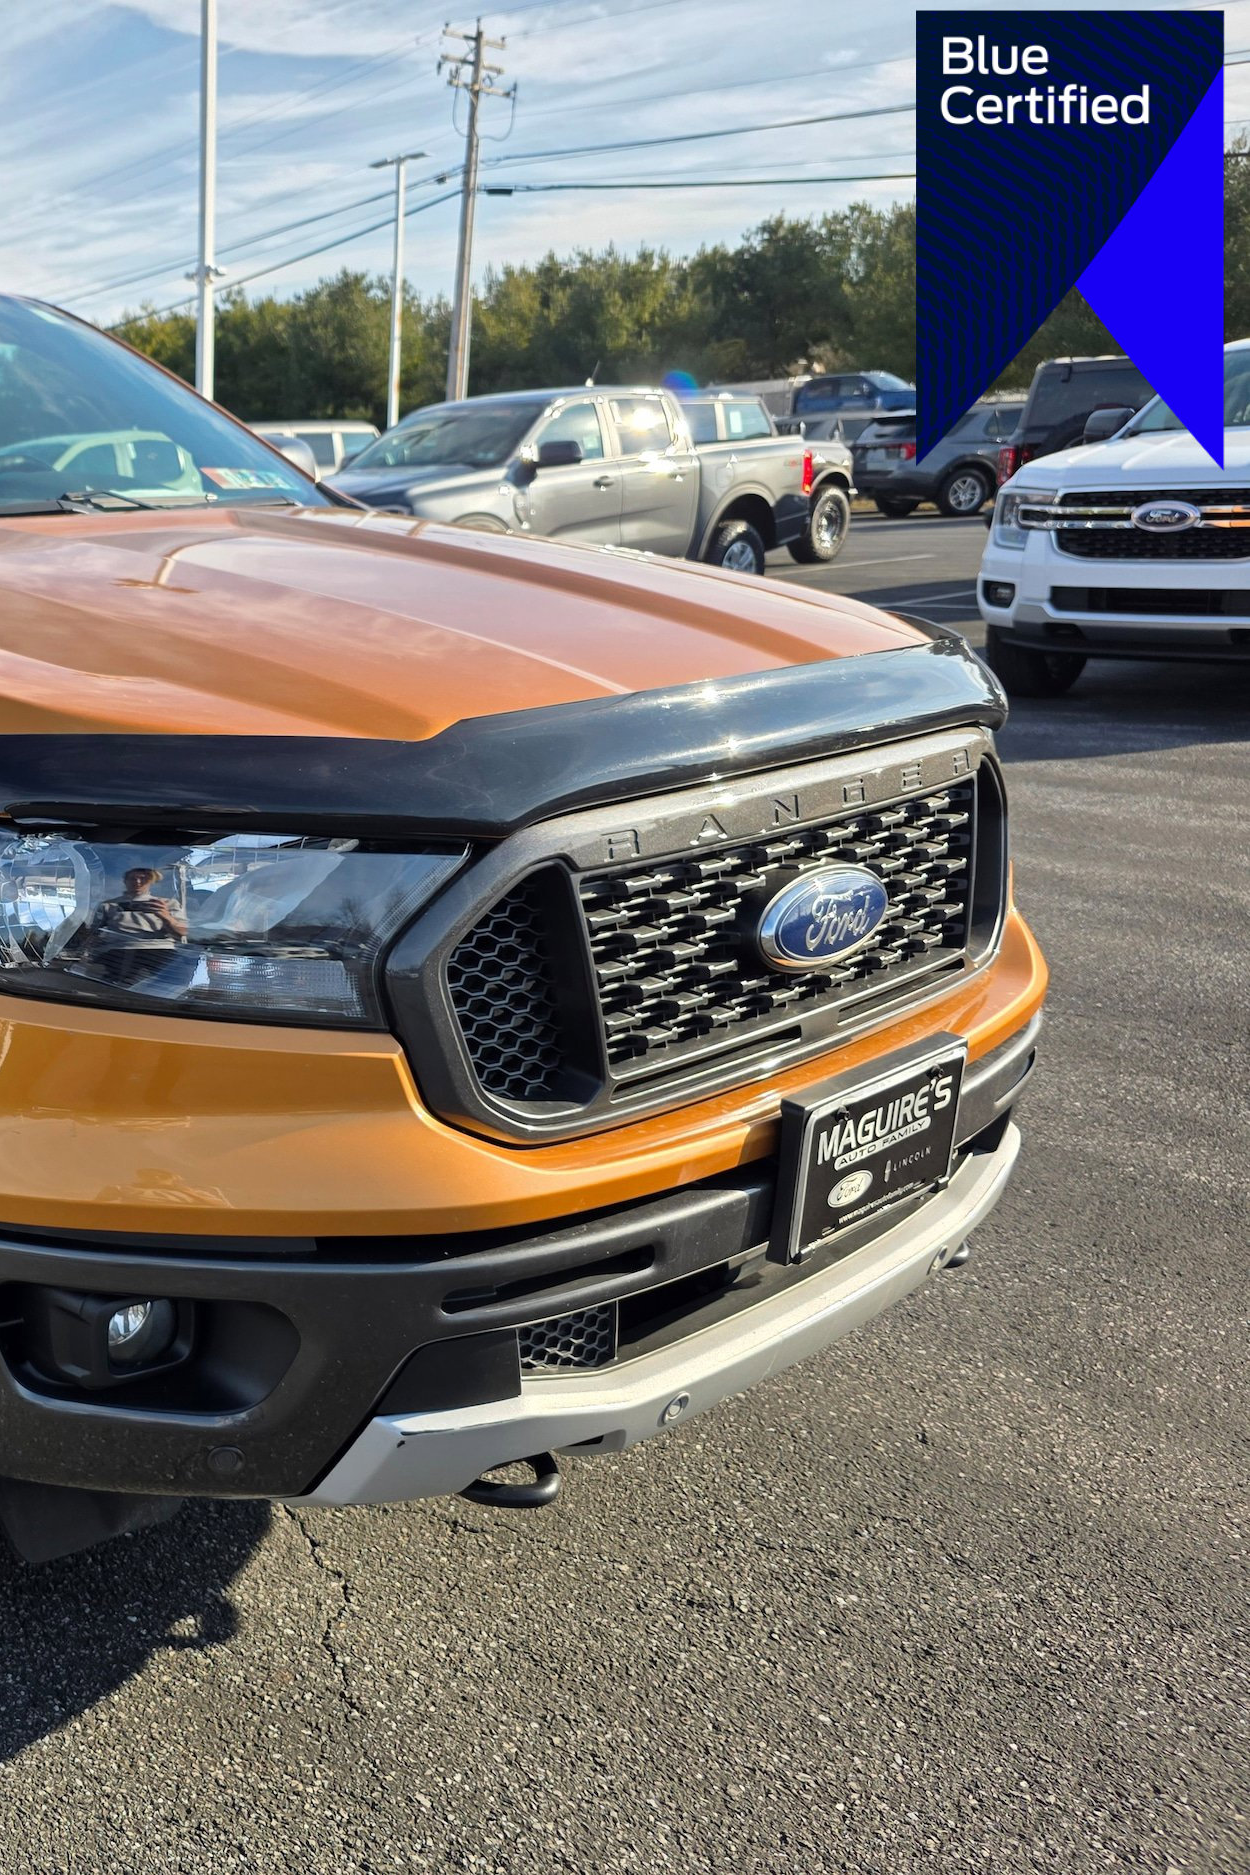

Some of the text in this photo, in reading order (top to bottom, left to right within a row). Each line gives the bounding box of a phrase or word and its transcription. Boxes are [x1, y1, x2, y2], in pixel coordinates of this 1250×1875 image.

[1146, 509, 1180, 523] Ford
[600, 748, 970, 862] RANGER
[806, 889, 872, 951] Ford
[817, 1075, 953, 1165] MAGUIRE'S
[838, 1119, 927, 1167] AUTO FAMILY
[893, 1147, 932, 1172] LINCOLN
[836, 1176, 864, 1202] Ford
